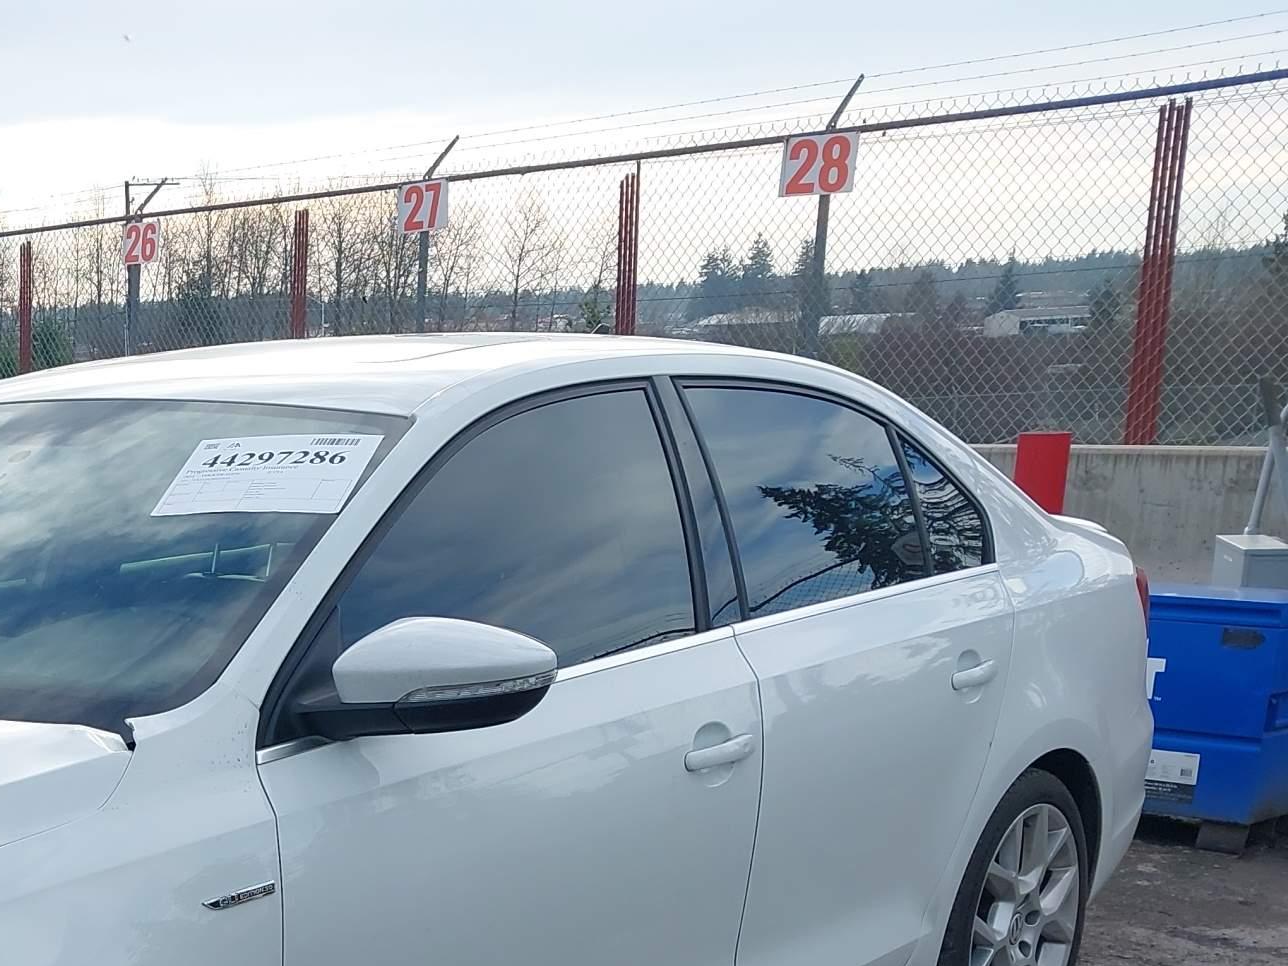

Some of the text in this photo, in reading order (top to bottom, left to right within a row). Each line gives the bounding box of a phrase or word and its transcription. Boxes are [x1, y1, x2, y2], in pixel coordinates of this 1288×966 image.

[785, 134, 851, 194] 28
[403, 182, 442, 231] 27
[124, 223, 157, 263] 26
[201, 450, 351, 468] 44297286
